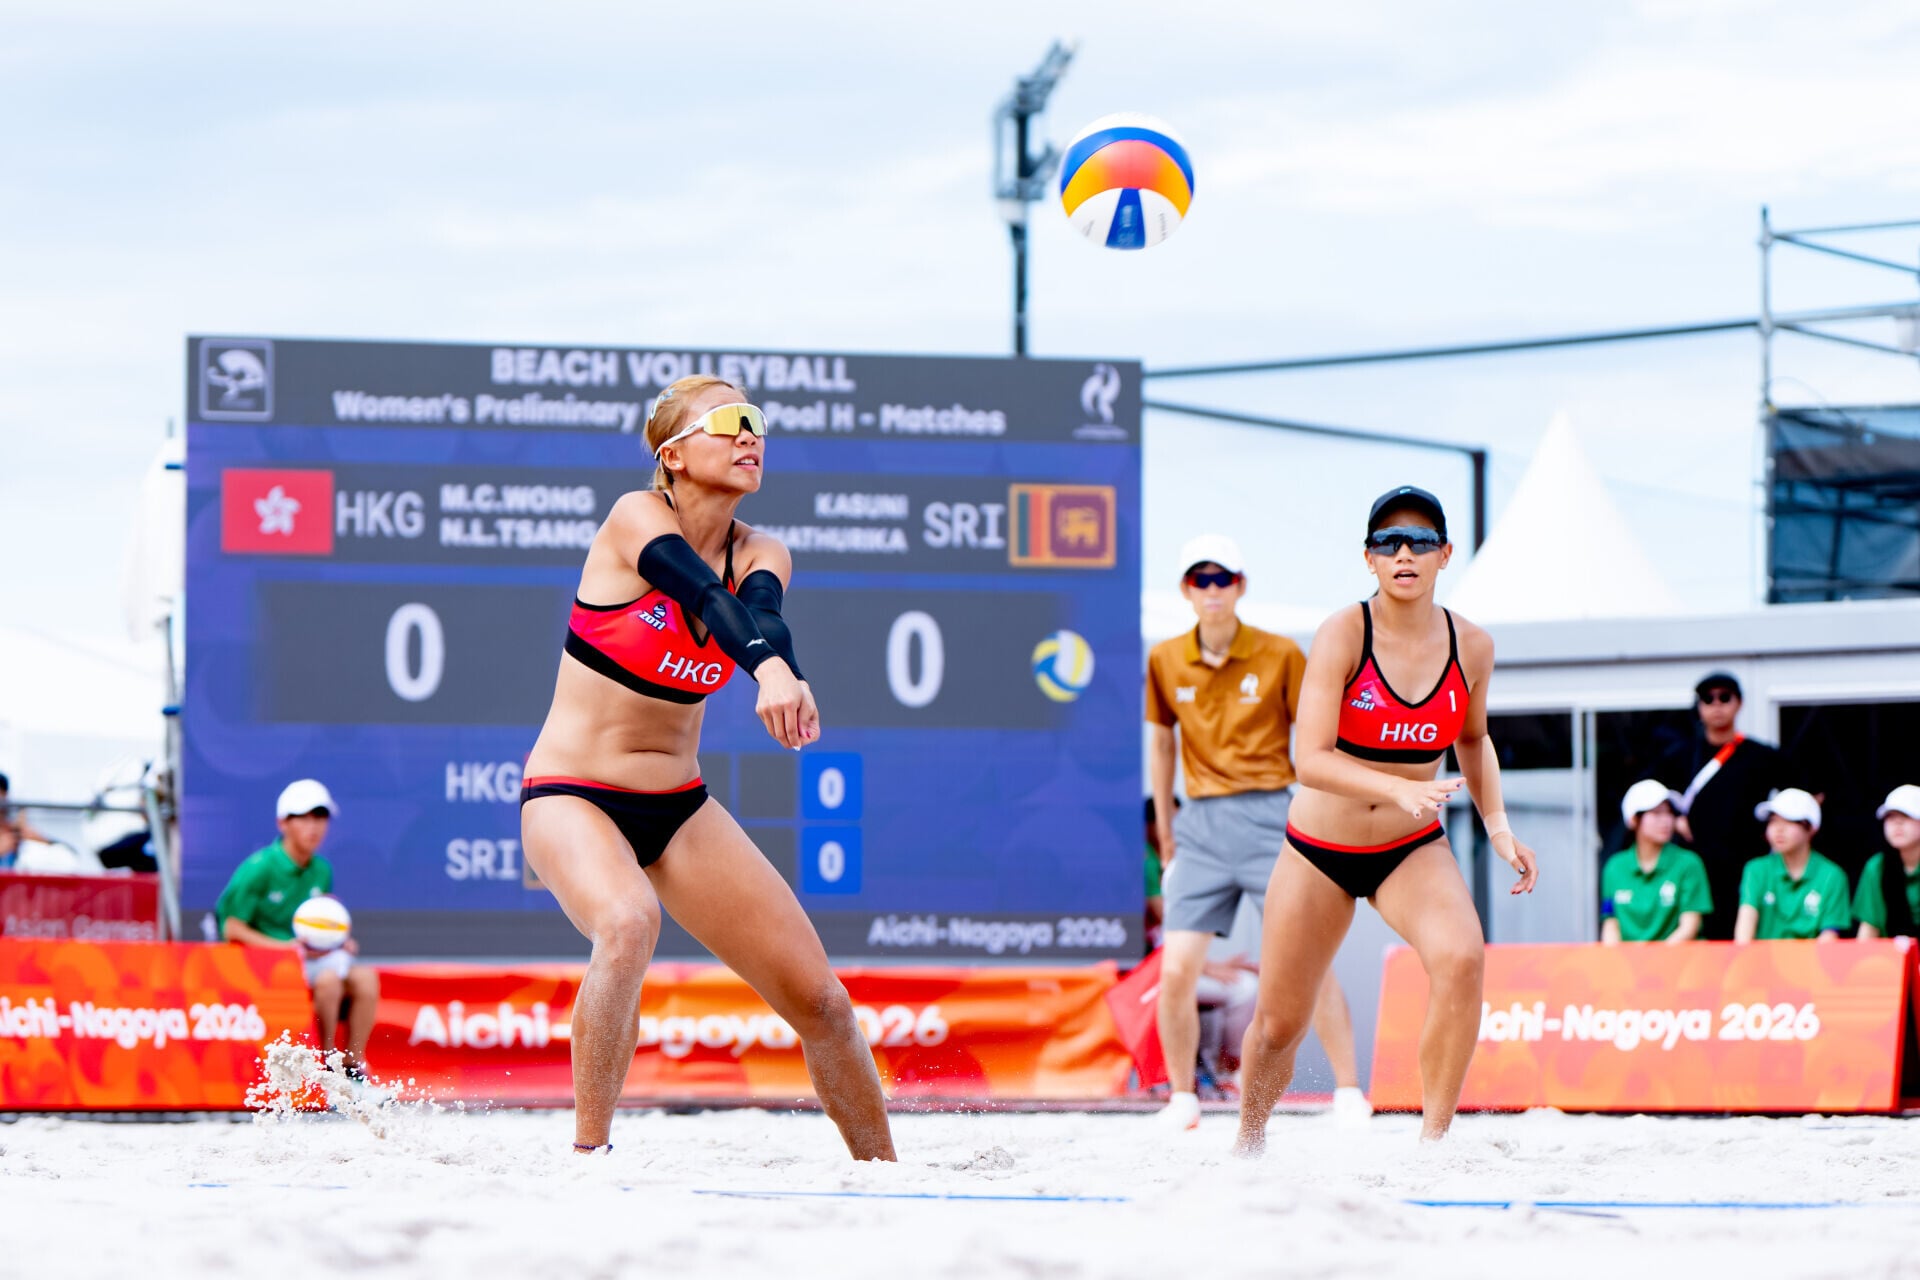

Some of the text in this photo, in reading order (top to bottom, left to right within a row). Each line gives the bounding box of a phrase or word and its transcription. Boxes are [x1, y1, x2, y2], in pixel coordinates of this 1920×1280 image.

[491, 350, 619, 386] BEACH
[333, 391, 470, 423] Women's
[475, 393, 640, 433] Preliminary
[763, 401, 826, 431] Pool
[831, 402, 855, 431] H
[880, 403, 1006, 435] Matches
[336, 490, 425, 538] HKG
[439, 484, 596, 515] M.C.WONG
[814, 493, 908, 519] KASUNI
[753, 525, 909, 552] HATHURIKA
[922, 501, 1006, 549] SRI
[384, 602, 445, 701] 0
[657, 651, 723, 685] HKG
[886, 610, 945, 707] 0
[1448, 690, 1457, 712] 1
[1379, 723, 1438, 743] HKG
[445, 761, 521, 804] HKG
[818, 768, 845, 808] 0
[445, 838, 519, 880] SRI
[818, 841, 845, 882] 0
[867, 914, 1128, 955] Aichi-Nagoya 2026
[0, 996, 266, 1049] ichi-Nagoya 2026
[408, 1000, 948, 1058] Aichi-agoya 026
[1477, 1001, 1821, 1051] ichi-Nagoya 2026
